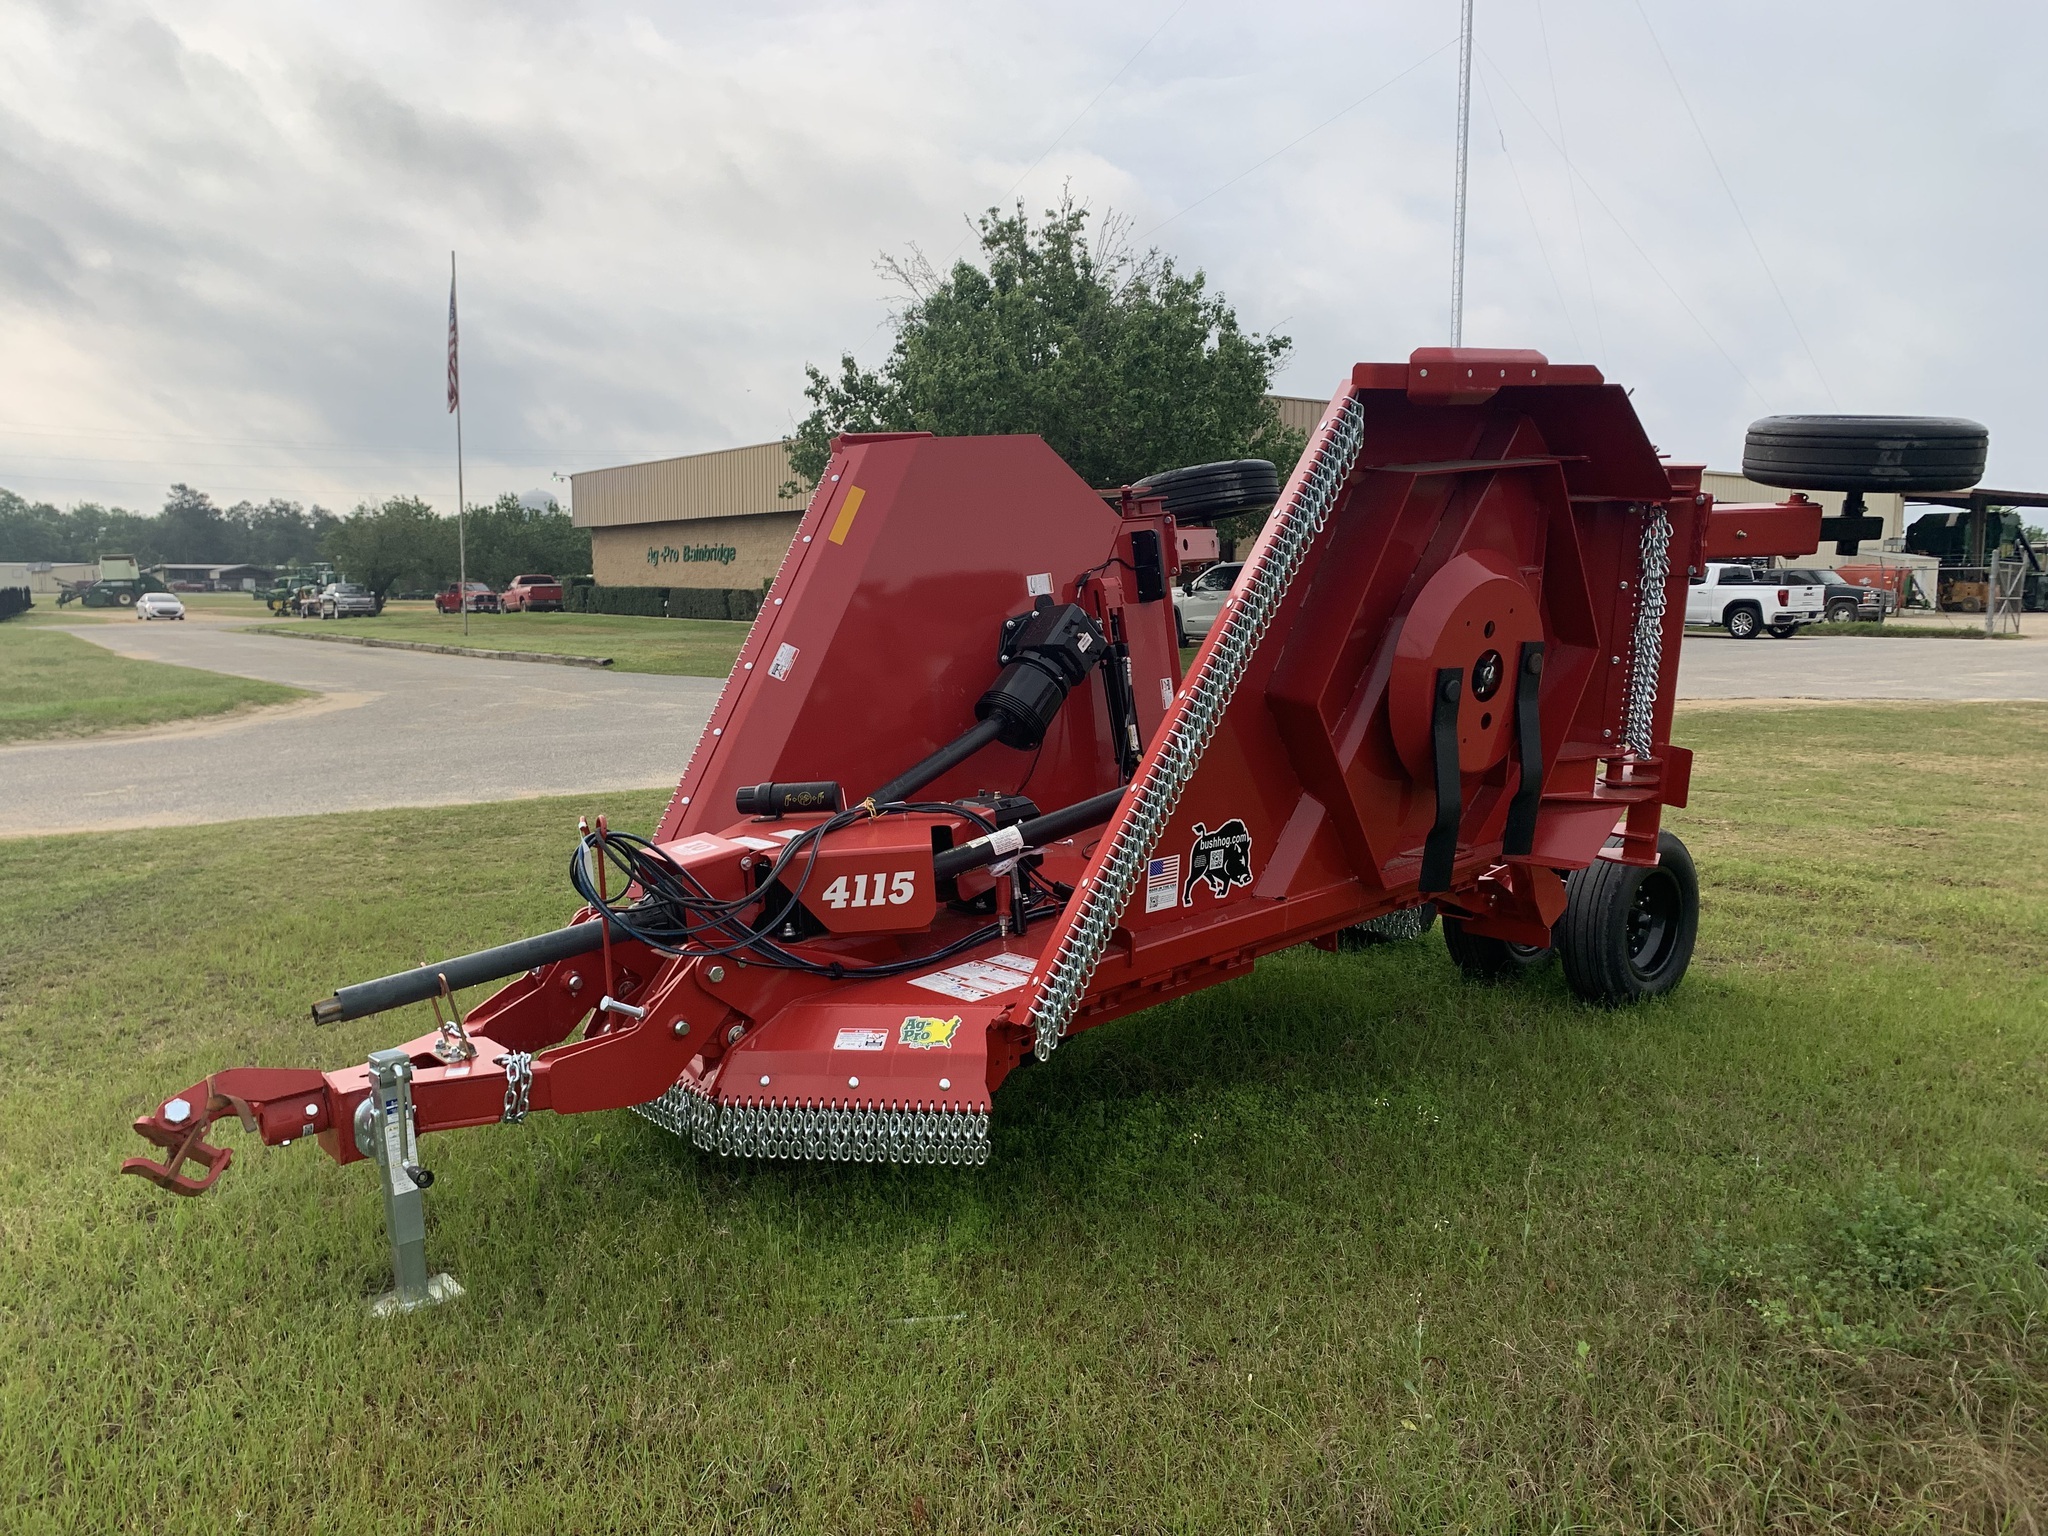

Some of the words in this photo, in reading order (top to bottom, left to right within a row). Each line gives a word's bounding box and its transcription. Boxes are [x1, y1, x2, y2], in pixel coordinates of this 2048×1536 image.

[683, 543, 736, 565] Bainbridge
[1200, 834, 1246, 850] bushhog.com
[821, 870, 916, 910] 4115
[902, 1030, 930, 1041] Pro
